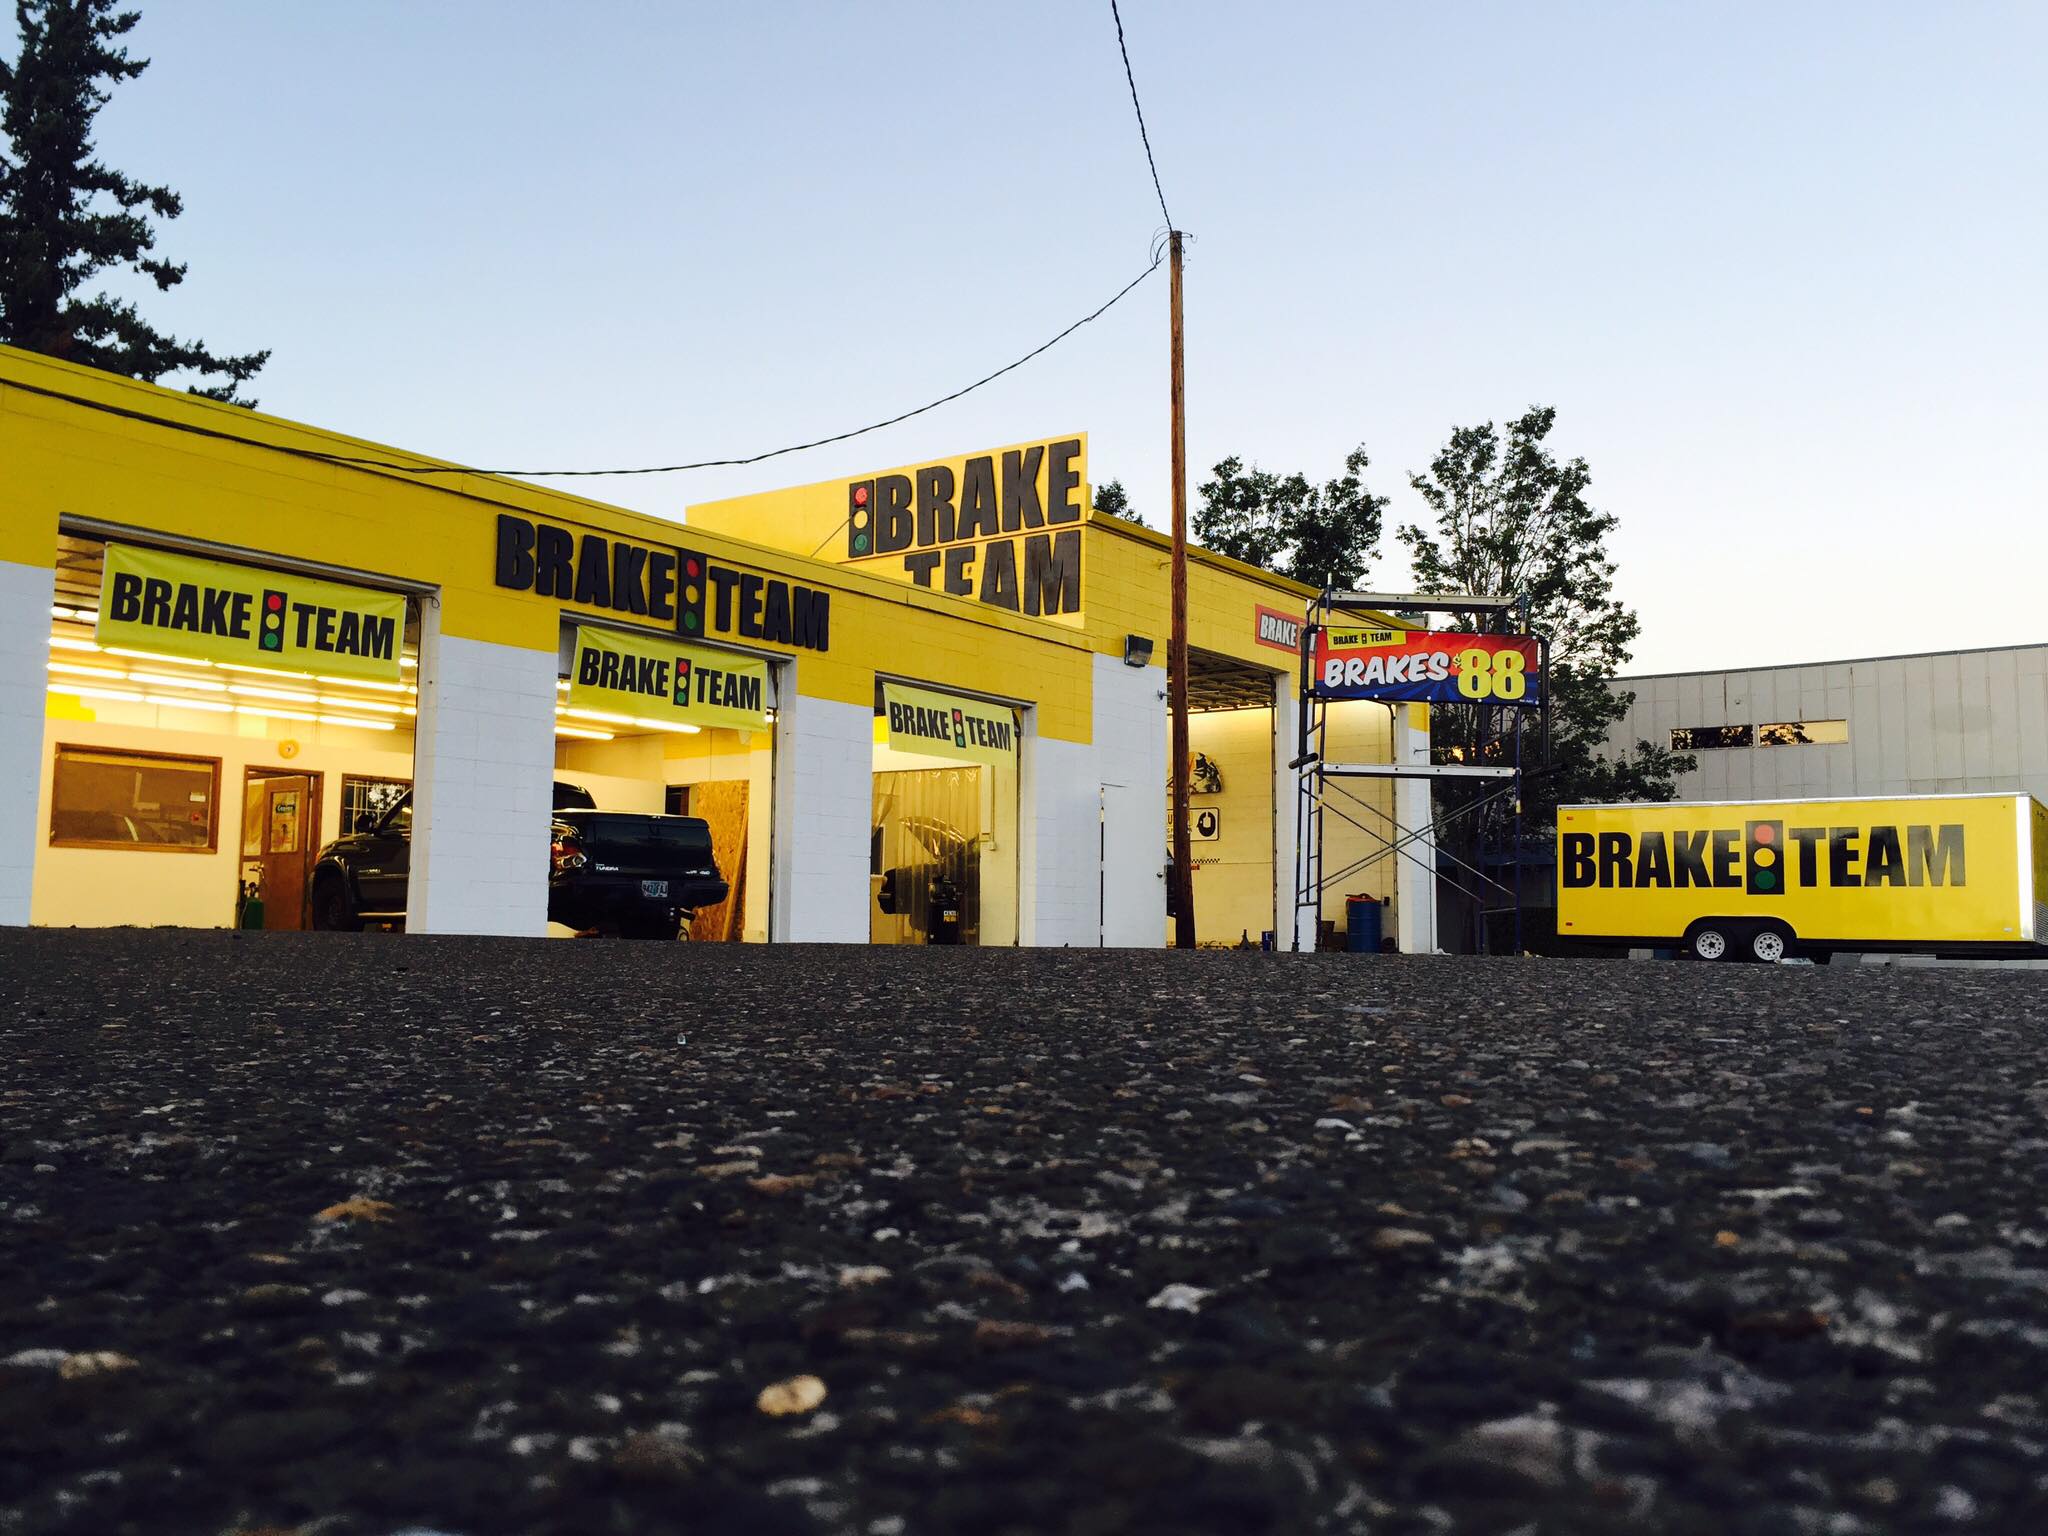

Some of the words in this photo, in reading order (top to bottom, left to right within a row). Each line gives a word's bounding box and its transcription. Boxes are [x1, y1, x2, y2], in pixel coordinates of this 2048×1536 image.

[875, 439, 1080, 553] BRAKE
[495, 513, 676, 620] BRAKE
[709, 565, 830, 652] TEAM
[904, 529, 1081, 617] TEAM
[110, 572, 253, 640] BRAKE
[292, 602, 395, 660] TEAM
[1260, 613, 1297, 648] BRAKE
[1333, 634, 1358, 645] BRAKE
[1370, 632, 1392, 643] TEAM
[578, 647, 670, 698] BRAKE
[694, 667, 761, 712] TEAM
[1324, 651, 1449, 688] BRAKES
[889, 701, 951, 741] BRAKE
[965, 716, 1012, 752] TEAM
[1562, 829, 1742, 888] BRAKE
[1788, 824, 1966, 888] TEAM
